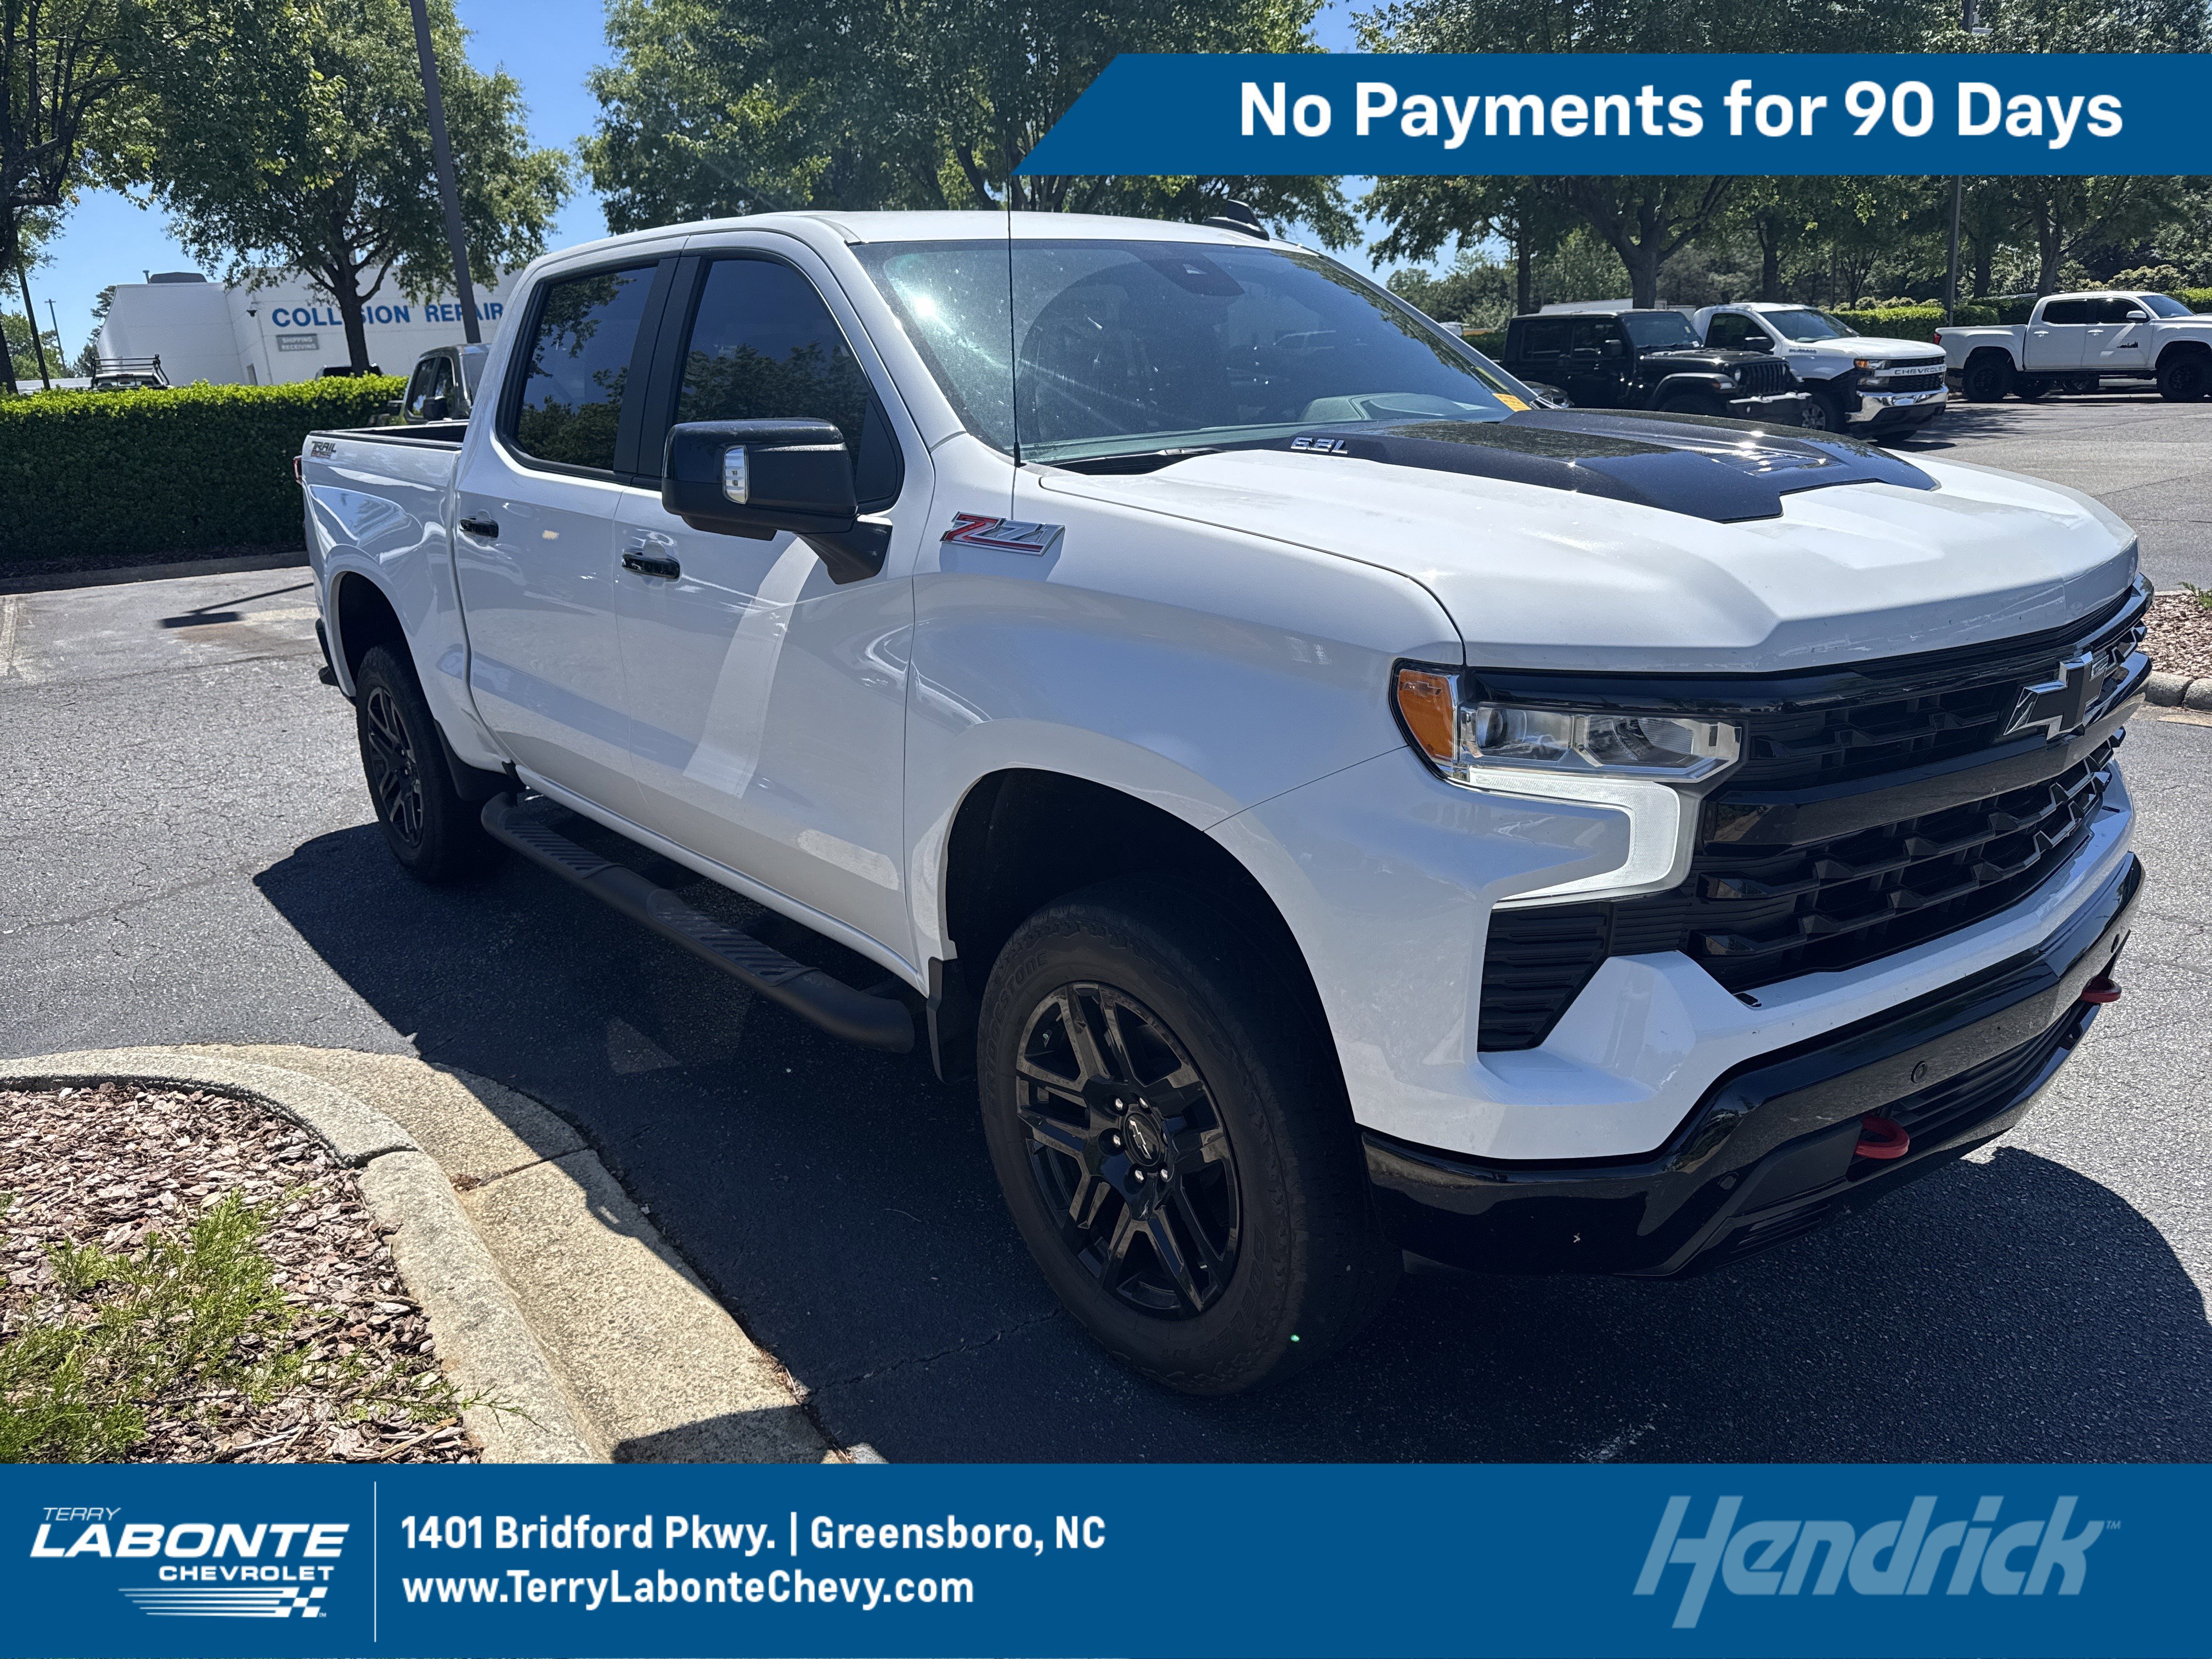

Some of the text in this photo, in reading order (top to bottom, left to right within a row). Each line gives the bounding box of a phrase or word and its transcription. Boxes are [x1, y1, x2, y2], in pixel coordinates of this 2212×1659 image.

[1894, 365, 1946, 375] CHEVROLET
[312, 441, 336, 453] TRAIL
[940, 511, 1065, 557] Z71
[985, 948, 1047, 1120] BRIDGESTONE
